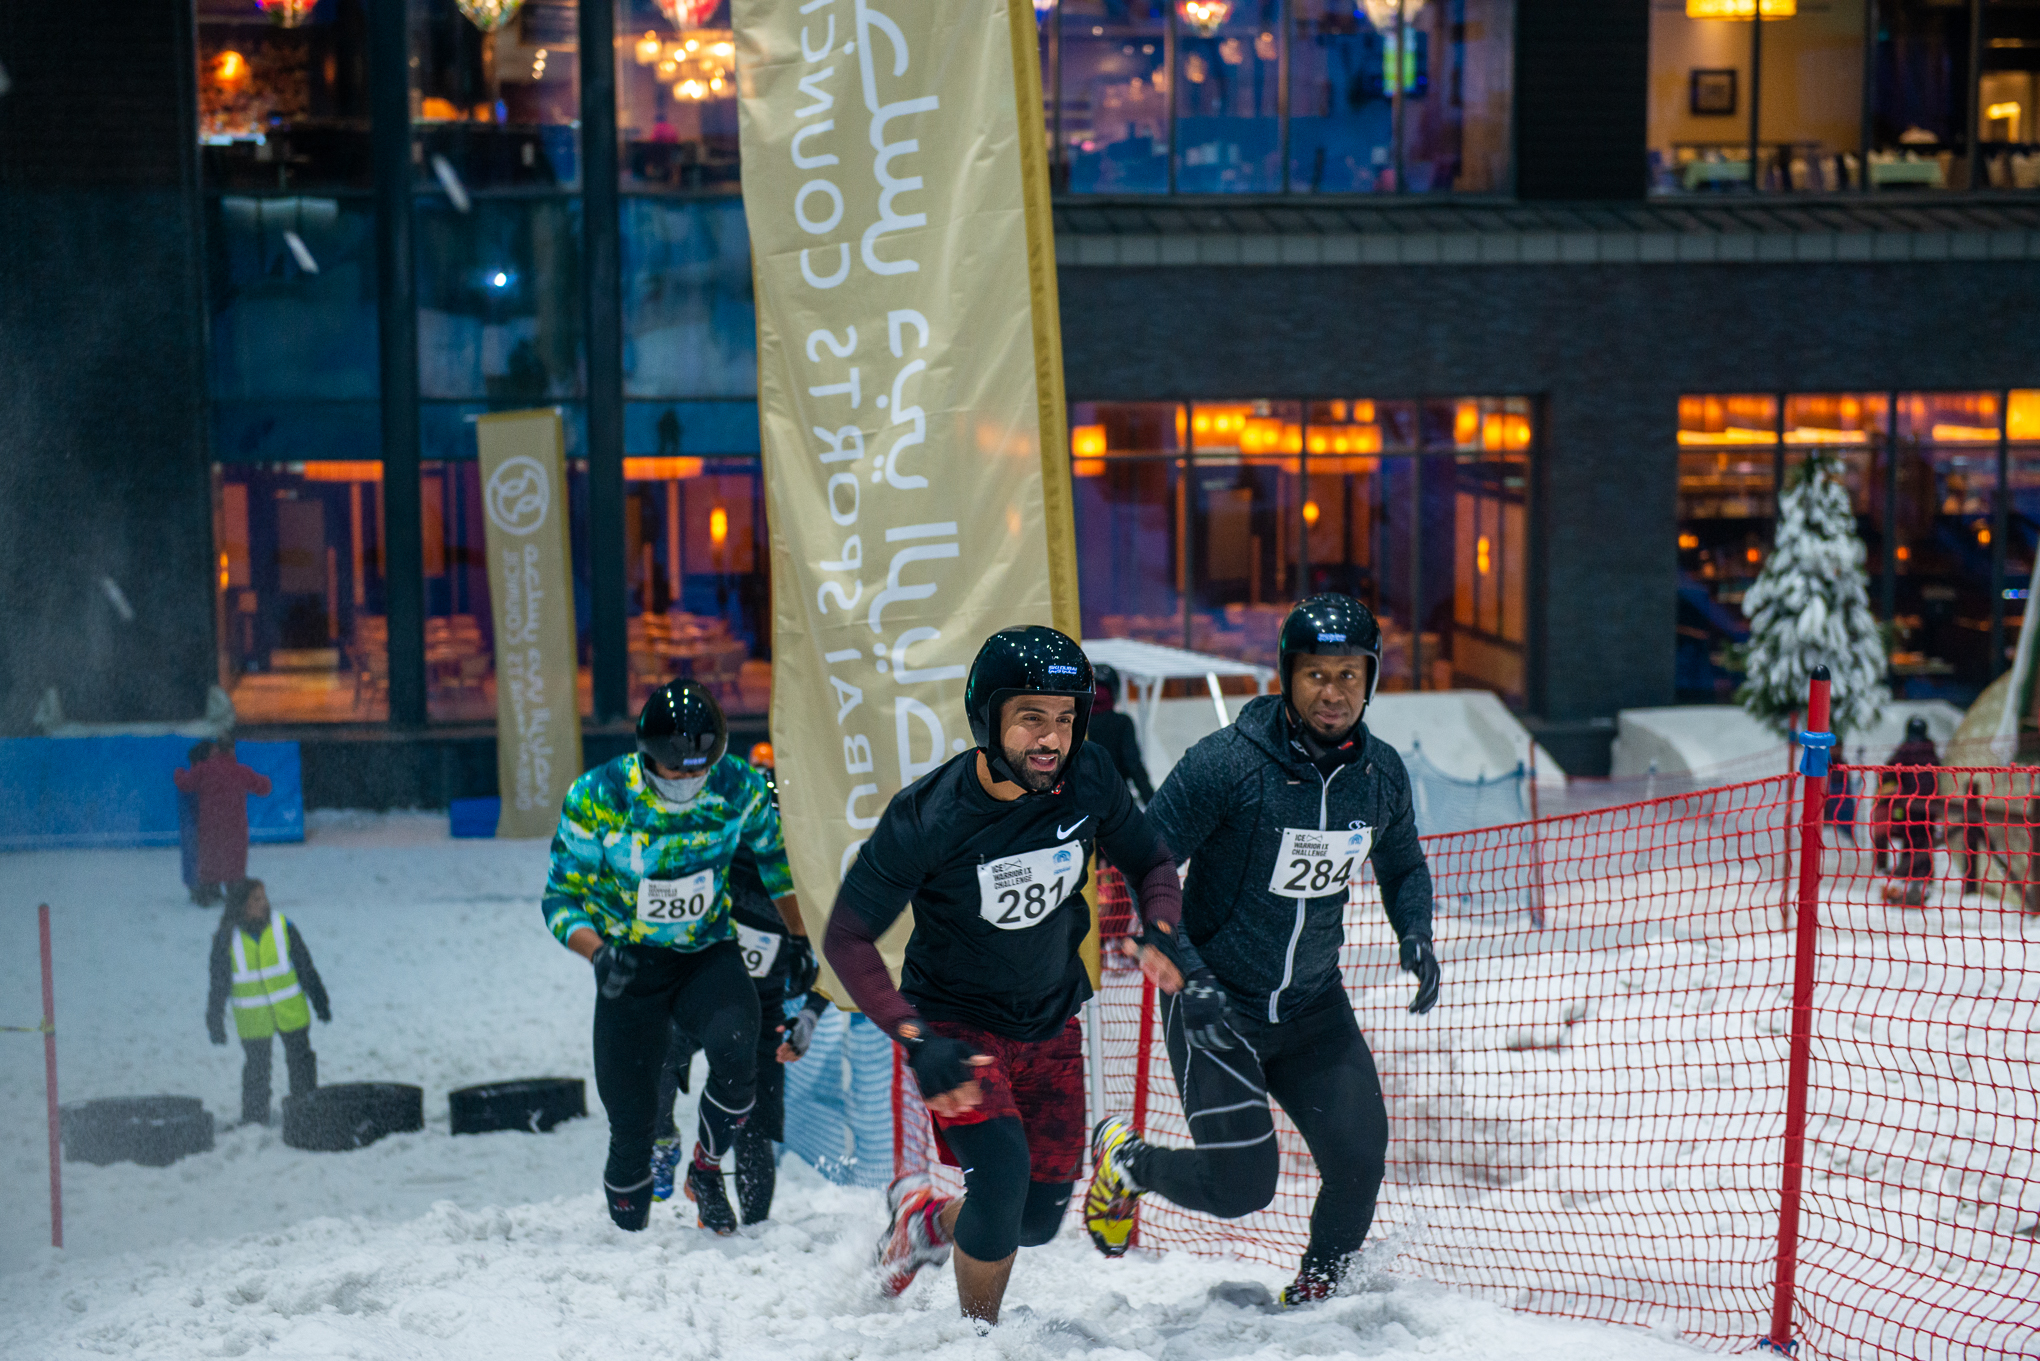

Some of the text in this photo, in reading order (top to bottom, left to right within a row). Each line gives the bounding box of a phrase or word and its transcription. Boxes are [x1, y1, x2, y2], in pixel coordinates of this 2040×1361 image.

[1295, 833, 1306, 842] ICE
[1294, 842, 1321, 850] WARRIOR
[1291, 848, 1328, 858] CHALLENGE
[991, 862, 1003, 873] ICE
[1283, 856, 1355, 892] 284
[993, 868, 1023, 881] WARRIOR
[994, 874, 1033, 890] CHALLENGE
[648, 893, 704, 919] 280
[996, 876, 1064, 924] 281
